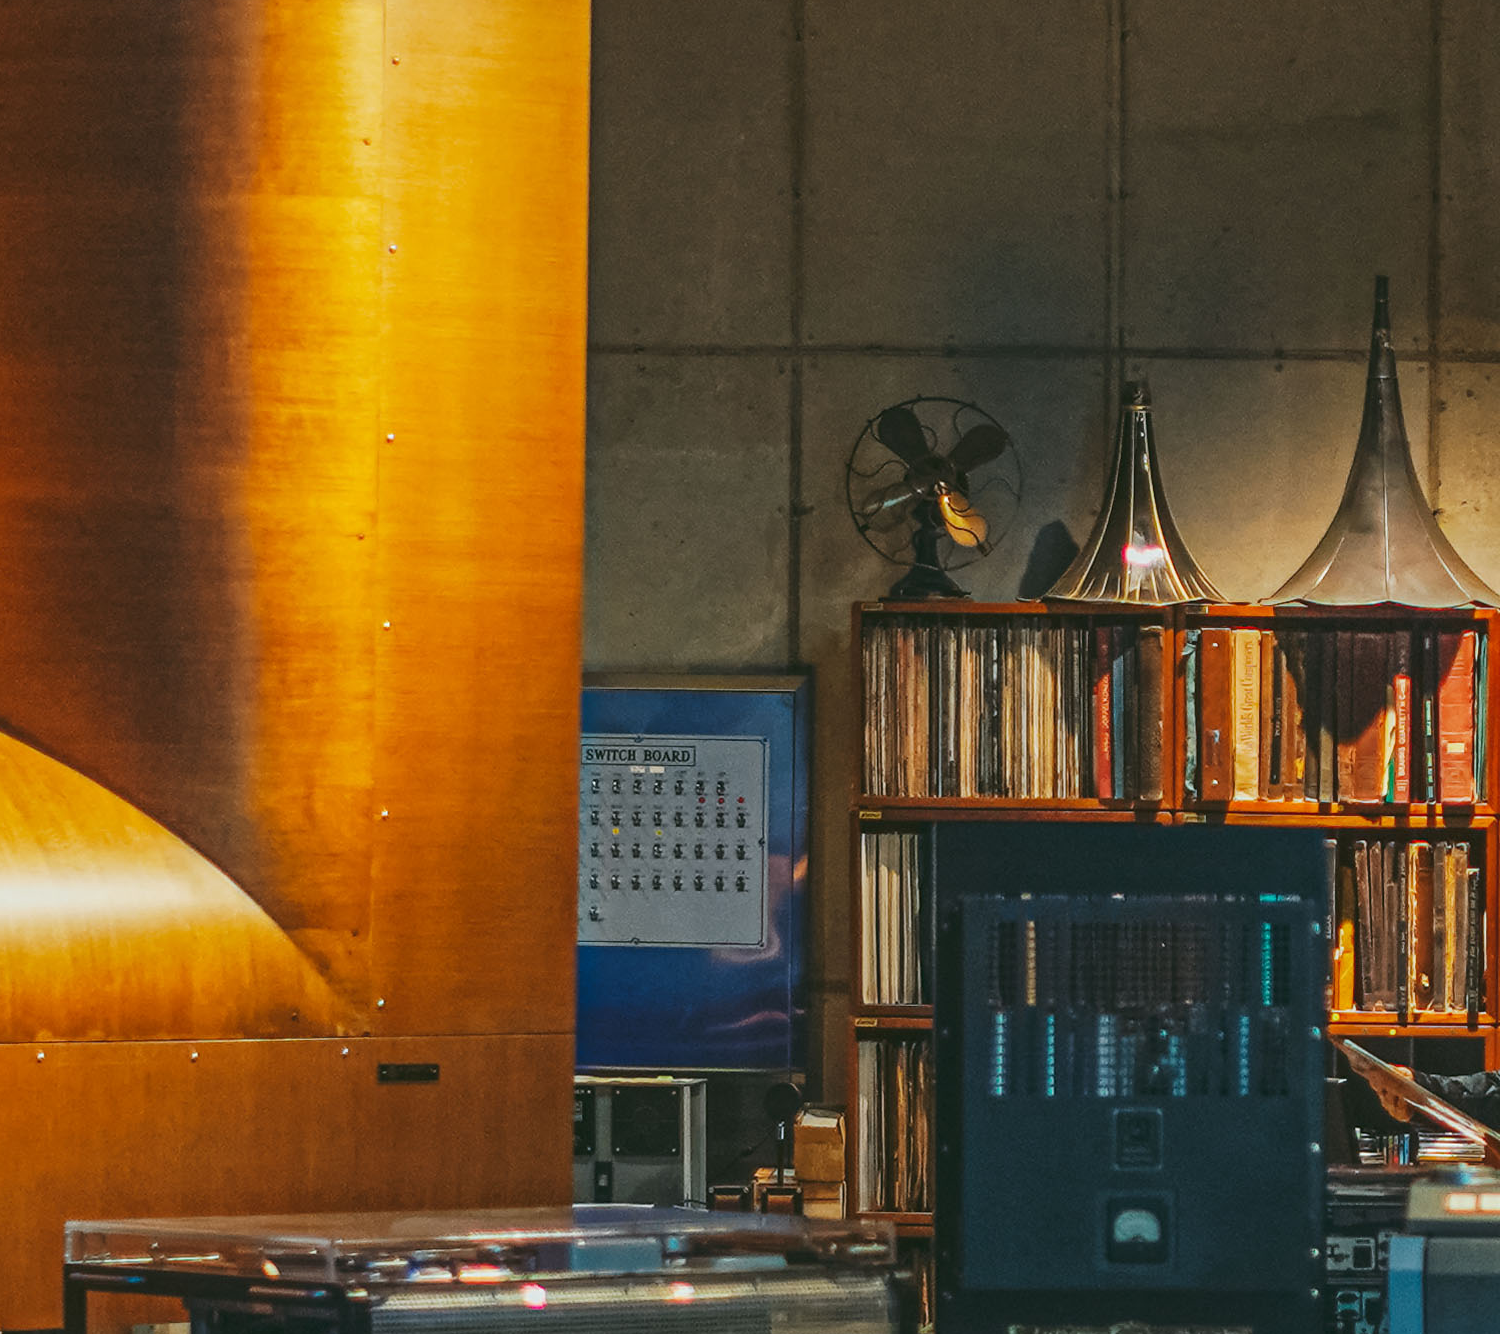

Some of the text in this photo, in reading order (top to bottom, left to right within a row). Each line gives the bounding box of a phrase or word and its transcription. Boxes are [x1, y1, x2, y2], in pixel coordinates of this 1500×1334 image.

[1240, 641, 1257, 686] Composers
[585, 748, 691, 763] SWITCH BOARD
